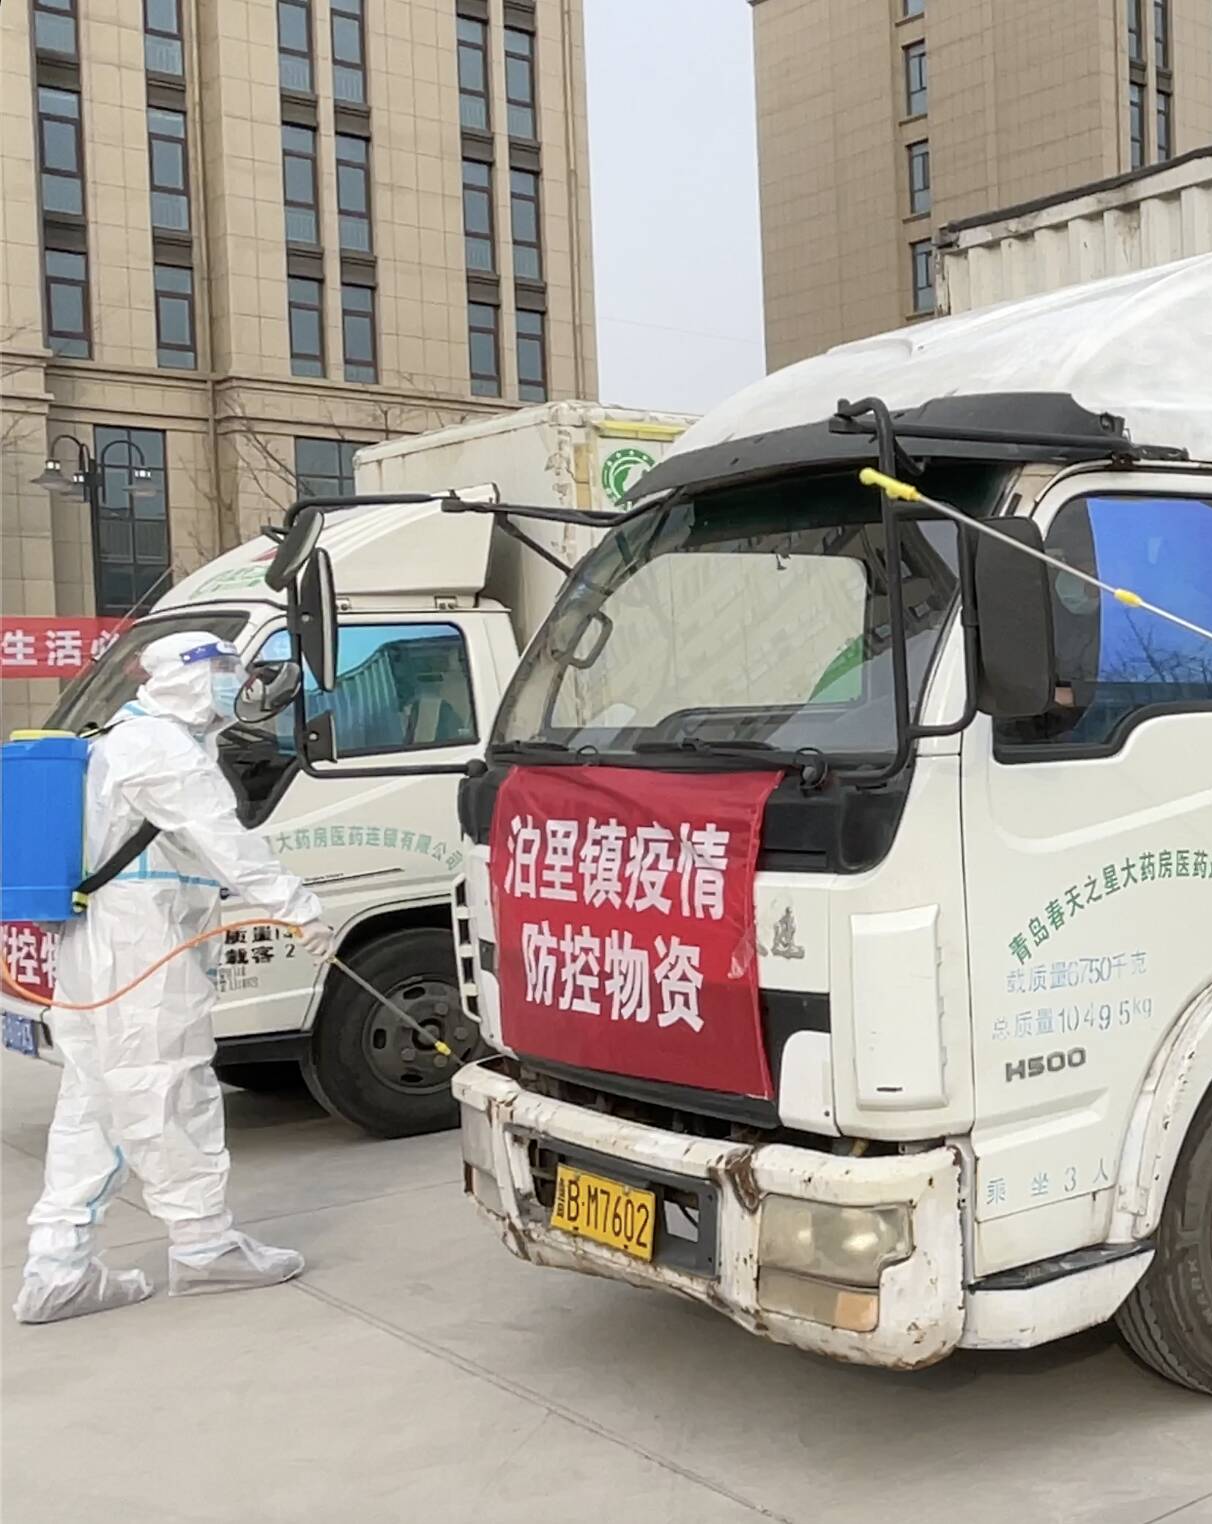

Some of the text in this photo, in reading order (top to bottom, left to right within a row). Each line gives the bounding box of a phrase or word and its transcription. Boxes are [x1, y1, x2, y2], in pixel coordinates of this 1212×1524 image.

[503, 814, 730, 921] 泊里镇疫情
[522, 920, 705, 1033] 防控物资
[1005, 1046, 1087, 1083] H500
